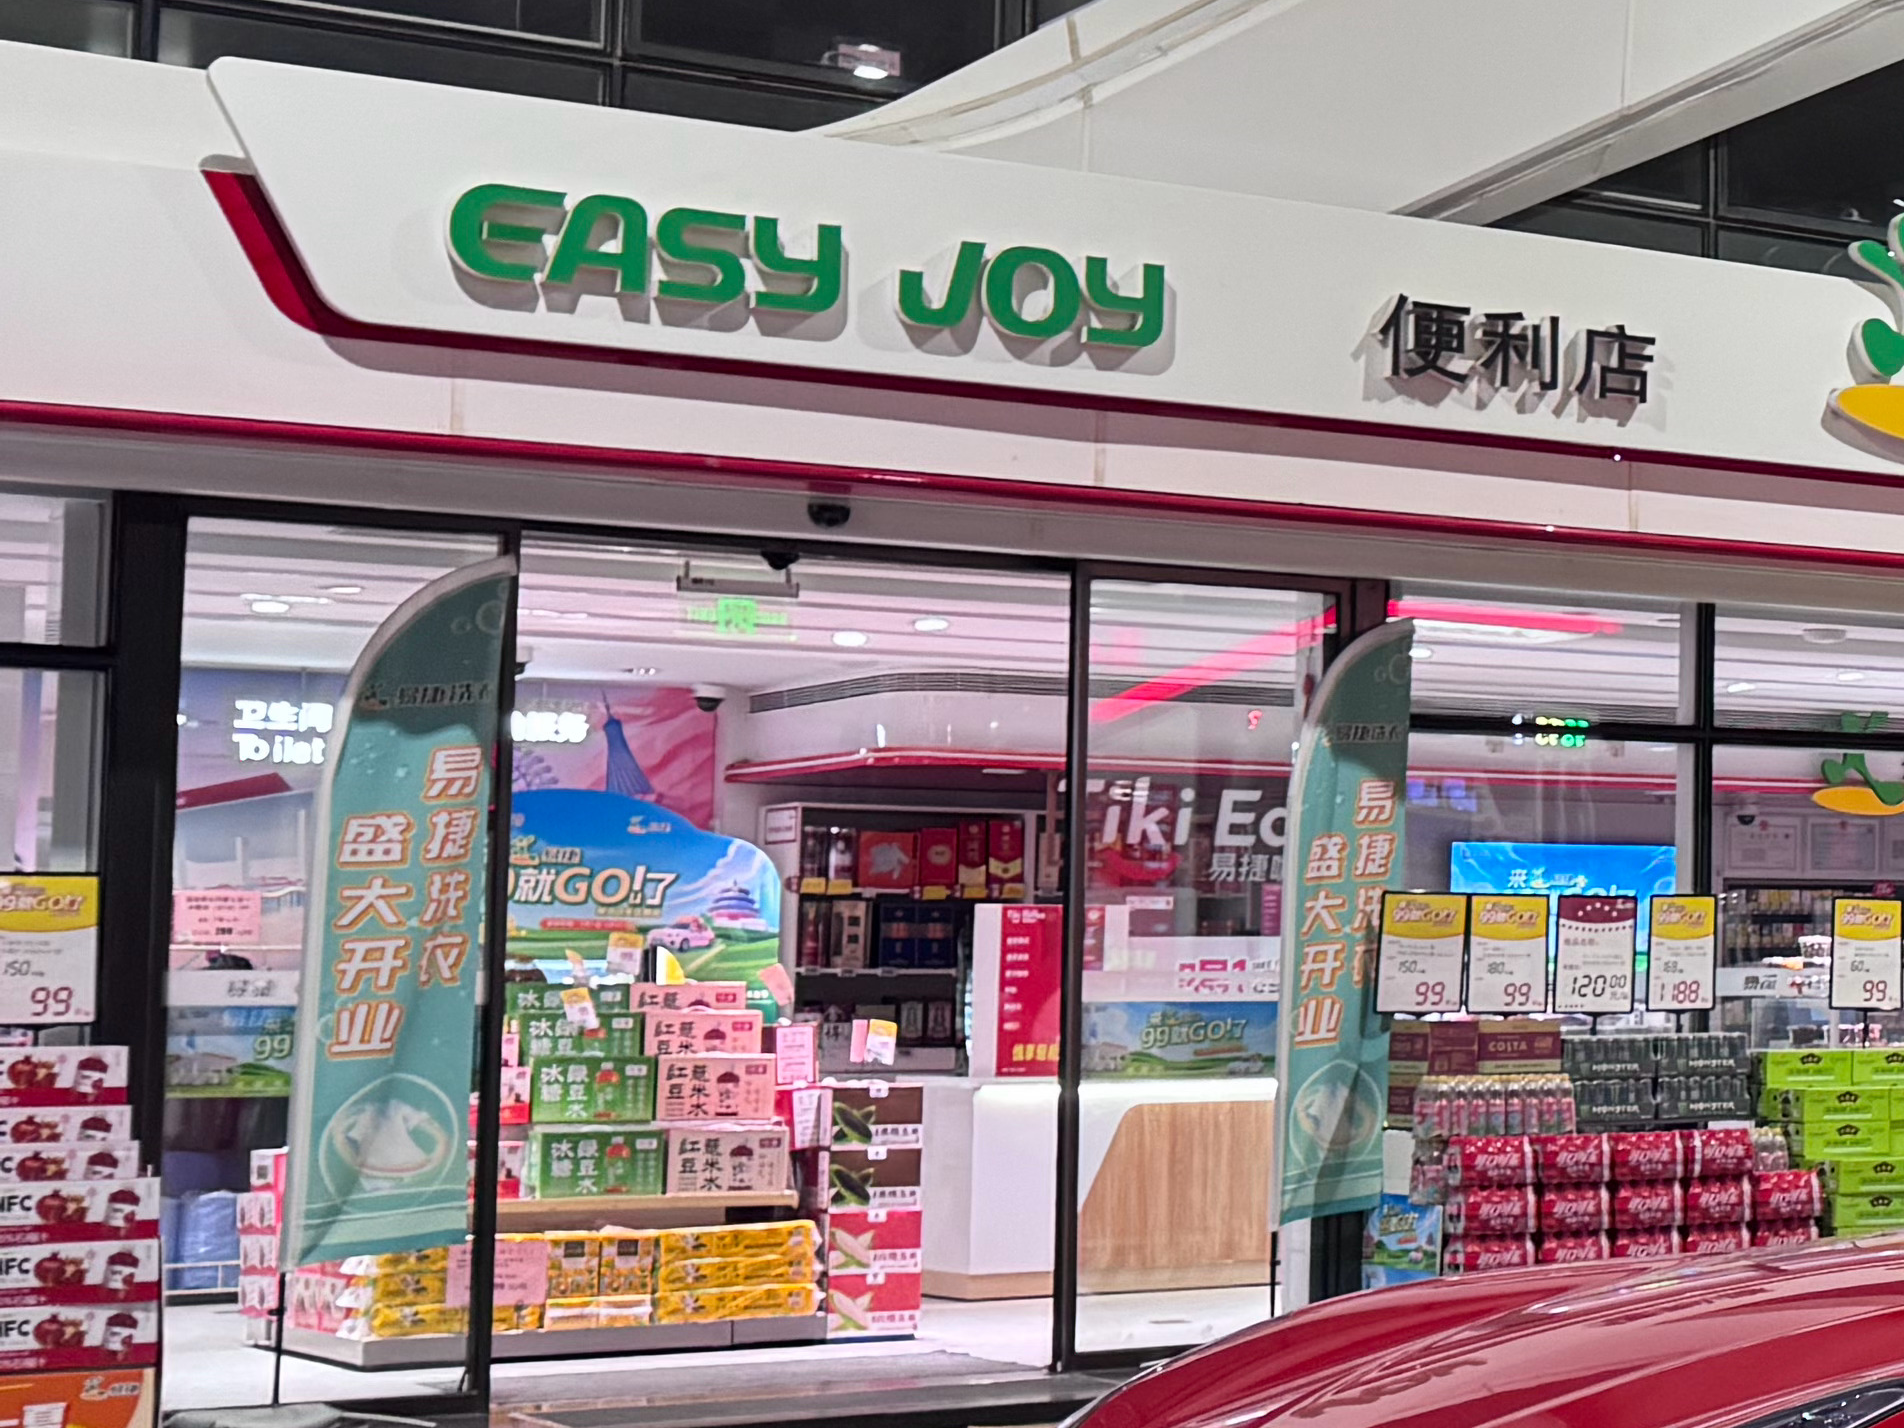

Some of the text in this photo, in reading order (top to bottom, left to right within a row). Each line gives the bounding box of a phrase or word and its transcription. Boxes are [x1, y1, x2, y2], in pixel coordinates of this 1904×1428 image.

[448, 182, 1166, 350] EASY JOY
[1377, 292, 1658, 405] 便利店
[231, 732, 326, 765] Toilet
[419, 743, 485, 988] 易捷洗衣
[508, 864, 679, 907] 就GO!了
[326, 811, 415, 1060] 盛大开业
[1294, 832, 1349, 1048] 盛大开业
[1414, 981, 1446, 1007] 99
[1503, 982, 1532, 1007] 99
[1570, 974, 1608, 998] 120
[1862, 979, 1888, 1003] 99
[30, 986, 74, 1017] 99
[254, 1034, 293, 1061] 99
[1488, 1040, 1528, 1052] COSTA
[1592, 1062, 1641, 1073] MONSTER
[1689, 1059, 1736, 1070] MONSTER
[1592, 1105, 1641, 1116] MONSTER
[1689, 1102, 1736, 1113] MONSTER
